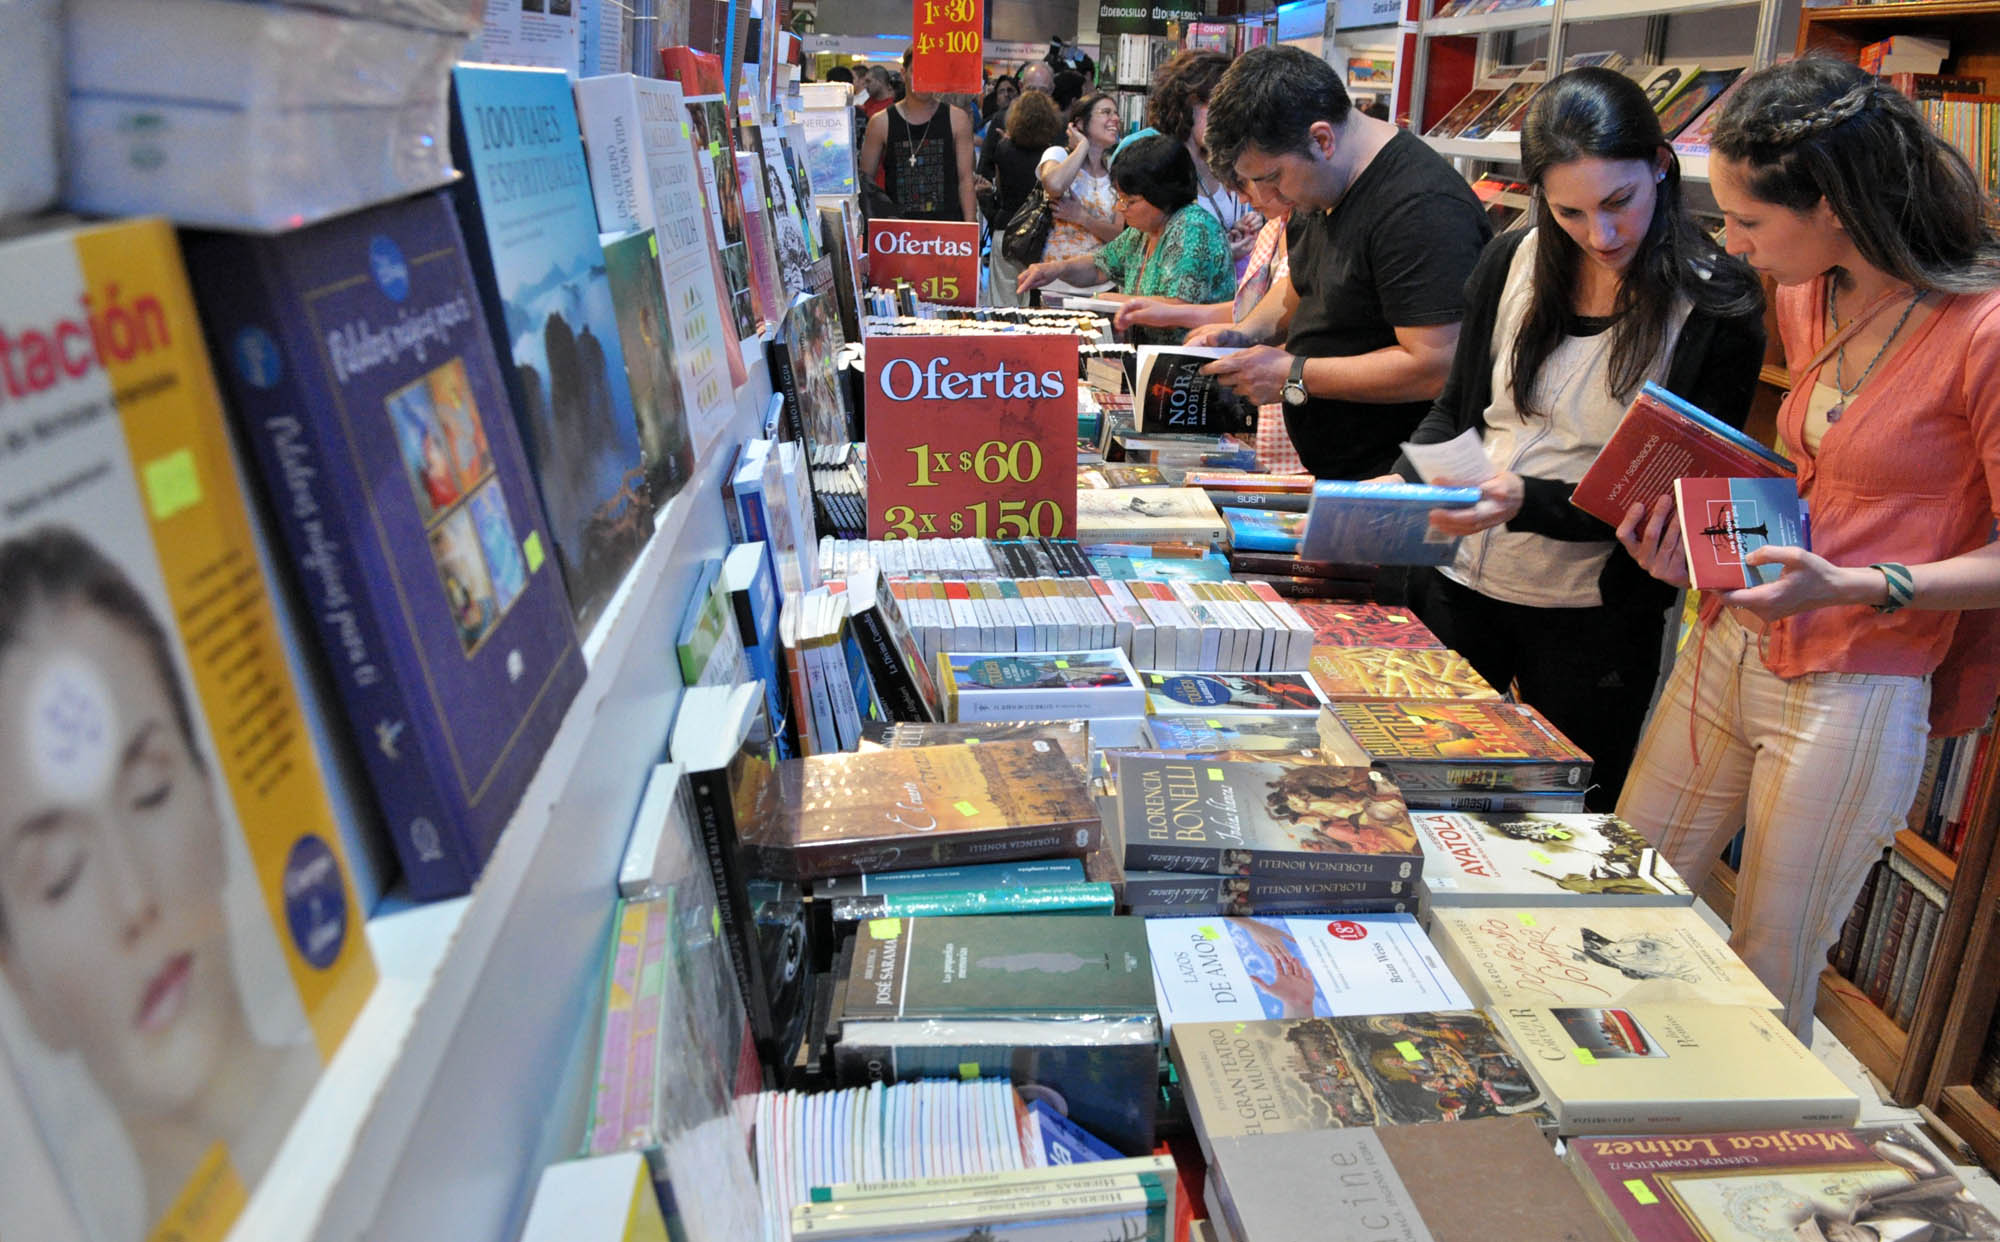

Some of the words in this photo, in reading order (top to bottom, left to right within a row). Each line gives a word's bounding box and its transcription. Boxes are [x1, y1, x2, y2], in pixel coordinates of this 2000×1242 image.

[923, 2, 940, 25] 1x
[944, 0, 975, 22] $30
[1108, 8, 1147, 18] DEBOLSILLO
[917, 32, 936, 55] 4x
[938, 31, 979, 54] $100
[475, 105, 515, 151] 100
[511, 104, 562, 149] VIAJES
[612, 115, 625, 145] VIDA
[803, 119, 842, 128] NERUDA
[606, 145, 624, 197] CUERPO
[617, 200, 628, 219] UN
[874, 231, 973, 257] Ofertas
[921, 277, 960, 300] $15
[880, 356, 1065, 401] Ofertas
[1169, 362, 1200, 426] NORA
[904, 444, 953, 487] 1x
[959, 440, 1043, 484] $60
[1237, 492, 1267, 504] sushi
[883, 506, 937, 541] 3x
[950, 500, 1064, 541] $150
[1728, 539, 1737, 555] Los
[1291, 564, 1316, 574] Pollo
[1445, 703, 1529, 758] ETERNA
[1145, 769, 1169, 840] FLORENCIA
[1167, 765, 1206, 842] BONELLI
[703, 805, 721, 857] MALPAS
[1010, 837, 1060, 849] FLORENCIA
[969, 840, 1008, 853] BONELLI
[1258, 859, 1306, 870] BONELLI
[1309, 861, 1373, 873] FLORENCIA
[712, 858, 729, 896] ELLEN
[1303, 882, 1367, 893] FLORENCIA
[1256, 884, 1301, 895] BONELLI
[1191, 933, 1228, 977] AMOR
[1373, 942, 1393, 963] Weiss
[1174, 951, 1199, 984] LAZOS
[1386, 963, 1404, 984] Brian
[875, 979, 893, 1006] JOSÉ
[1209, 981, 1239, 1005] DE
[1517, 1021, 1542, 1047] JULIO
[1664, 1014, 1700, 1048] Premios
[1208, 1028, 1240, 1074] TEATRO
[1233, 1038, 1270, 1090] MUNDO
[1227, 1077, 1258, 1119] GRAN
[1257, 1095, 1280, 1120] DEL
[1241, 1120, 1264, 1136] EL
[1592, 1136, 1721, 1157] Lainez
[1728, 1130, 1856, 1154] Mujica
[1624, 1156, 1699, 1169] COMPLETOS
[1699, 1155, 1759, 1166] CUENTOS
[1056, 1177, 1117, 1191] HIERBAS
[1061, 1191, 1123, 1205] HIERBAS
